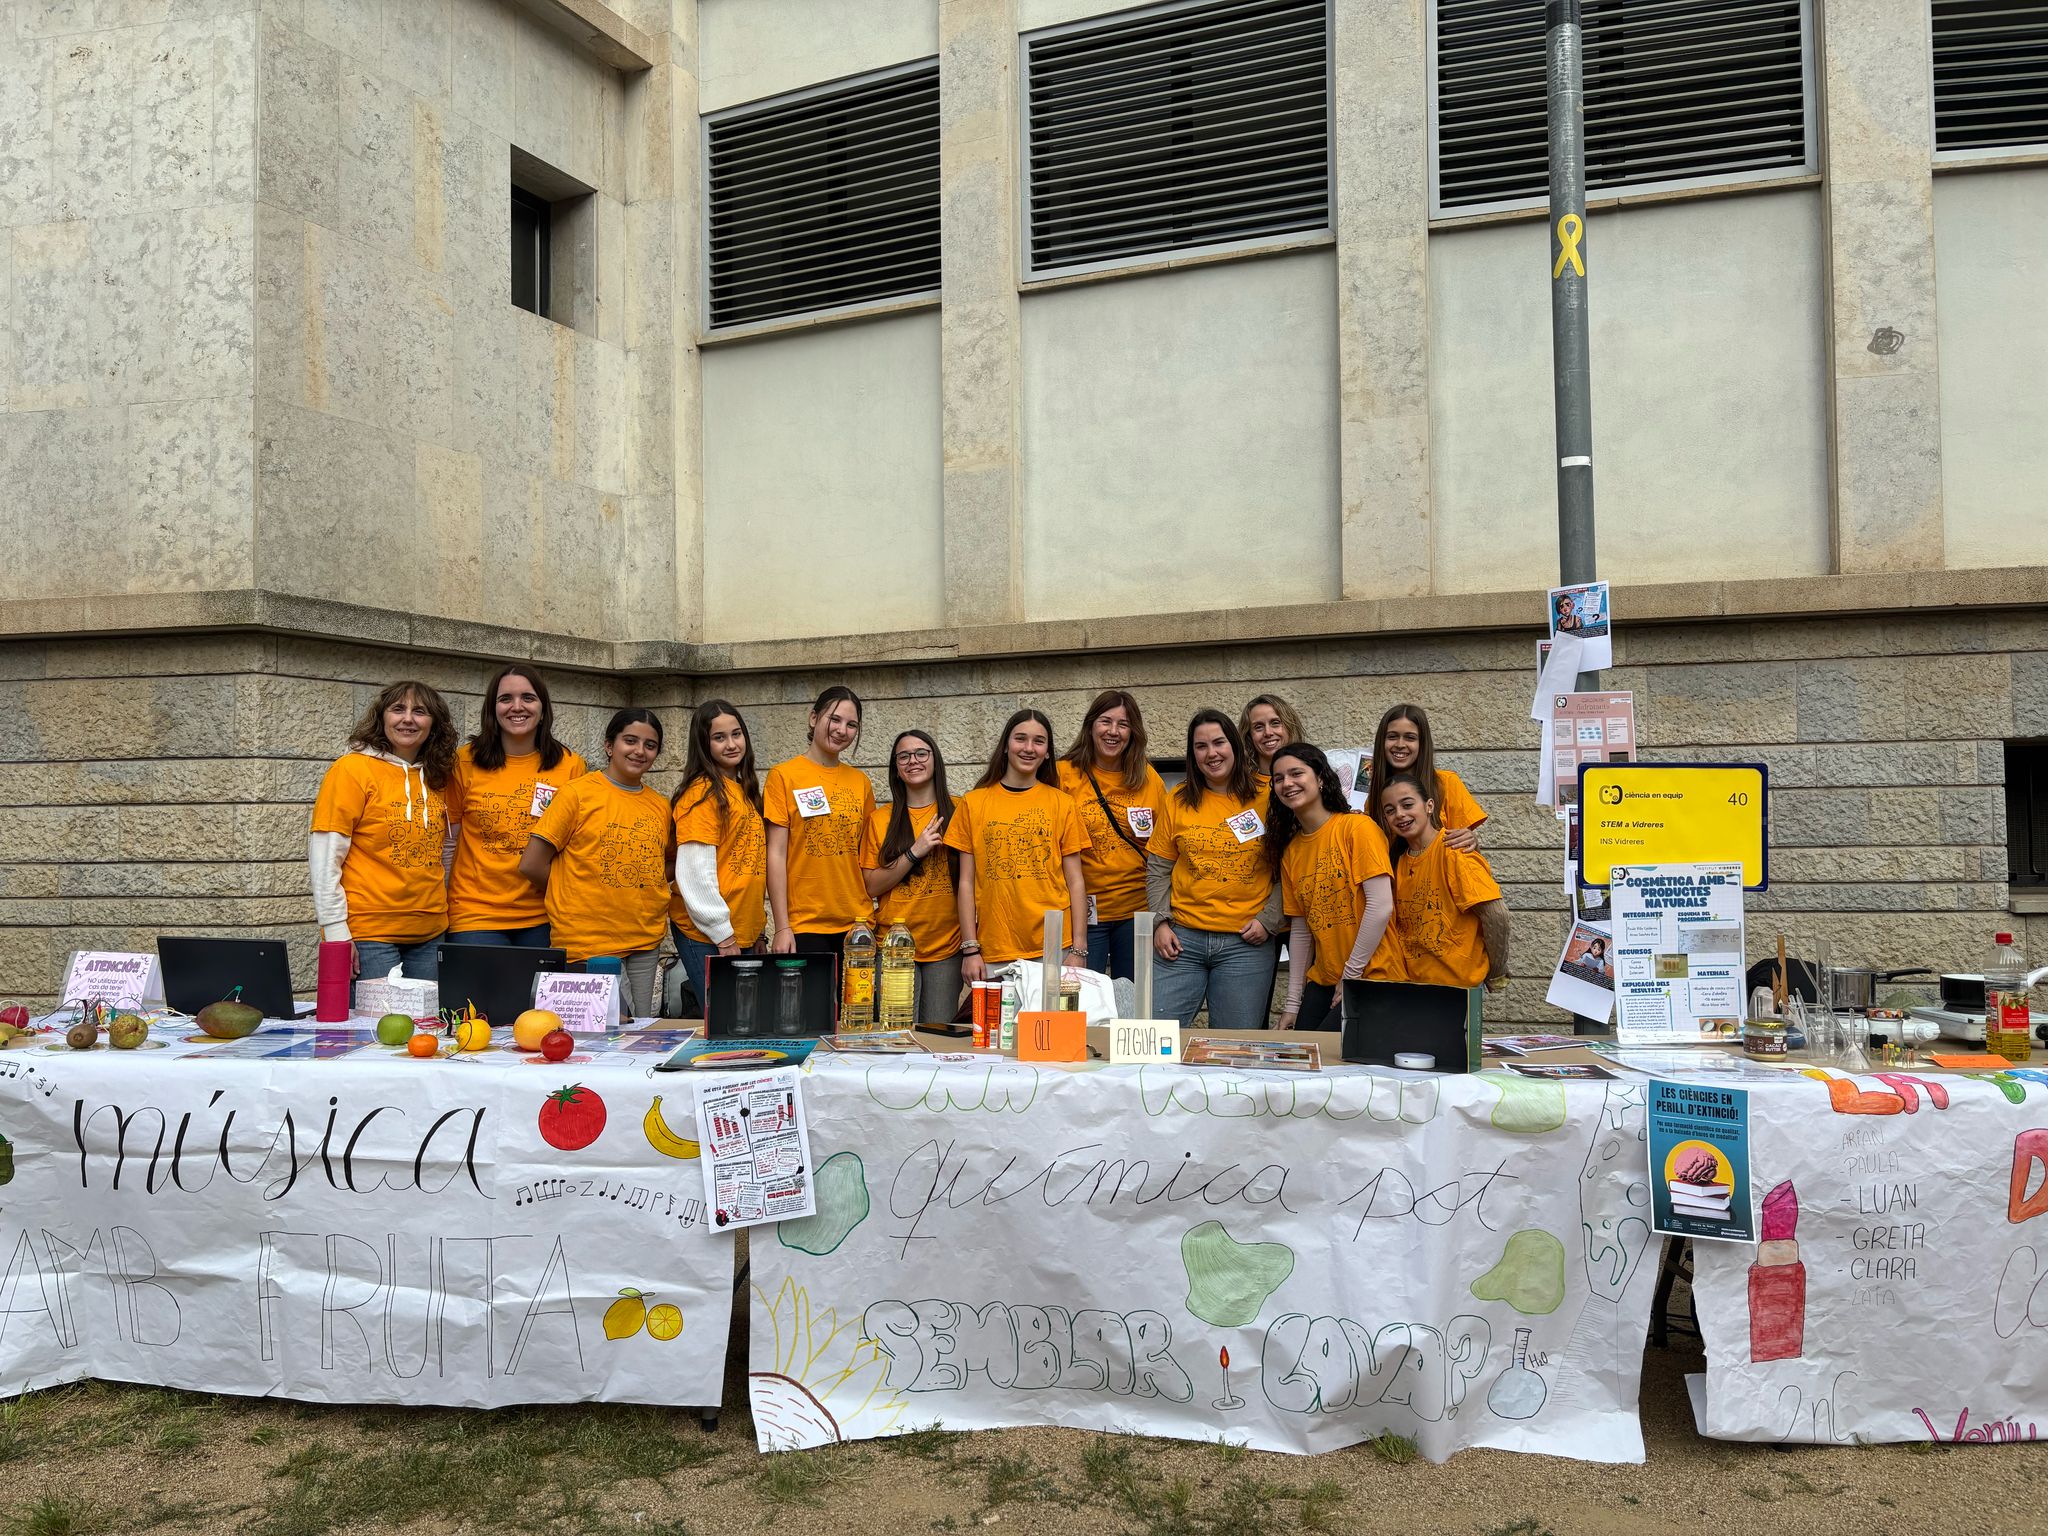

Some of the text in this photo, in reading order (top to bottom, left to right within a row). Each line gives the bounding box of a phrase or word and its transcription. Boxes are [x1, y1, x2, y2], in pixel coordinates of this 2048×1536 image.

[1624, 791, 1650, 799] ciència
[1663, 791, 1684, 800] equip
[1727, 792, 1748, 806] 40
[1631, 820, 1664, 828] Vidreres
[1626, 874, 1726, 888] COSMÈTICA AMB
[1640, 886, 1711, 898] PRODUCTES
[1645, 897, 1708, 909] NATURALS
[84, 958, 141, 973] ATENCIÓ!!
[549, 978, 603, 994] ATENCIÓ!!
[1622, 980, 1655, 988] EXPLICACIÓ
[559, 1012, 586, 1020] roblemes
[1034, 1019, 1051, 1051] OLI
[1116, 1026, 1157, 1056] AIGUA
[1661, 1087, 1733, 1106] LES CIÈNCIES EN
[1656, 1100, 1739, 1120] PERILL D'EXTINCIÓ!
[73, 1090, 497, 1200] música
[1843, 1150, 1899, 1177] PAULA
[889, 1139, 1298, 1261] química
[1337, 1159, 1519, 1242] pot
[1852, 1222, 1926, 1250] GRETA
[1850, 1256, 1916, 1280] CLARA
[0, 1226, 585, 1379] AMB FRUITA
[863, 1299, 1194, 1403] SEMBLAR
